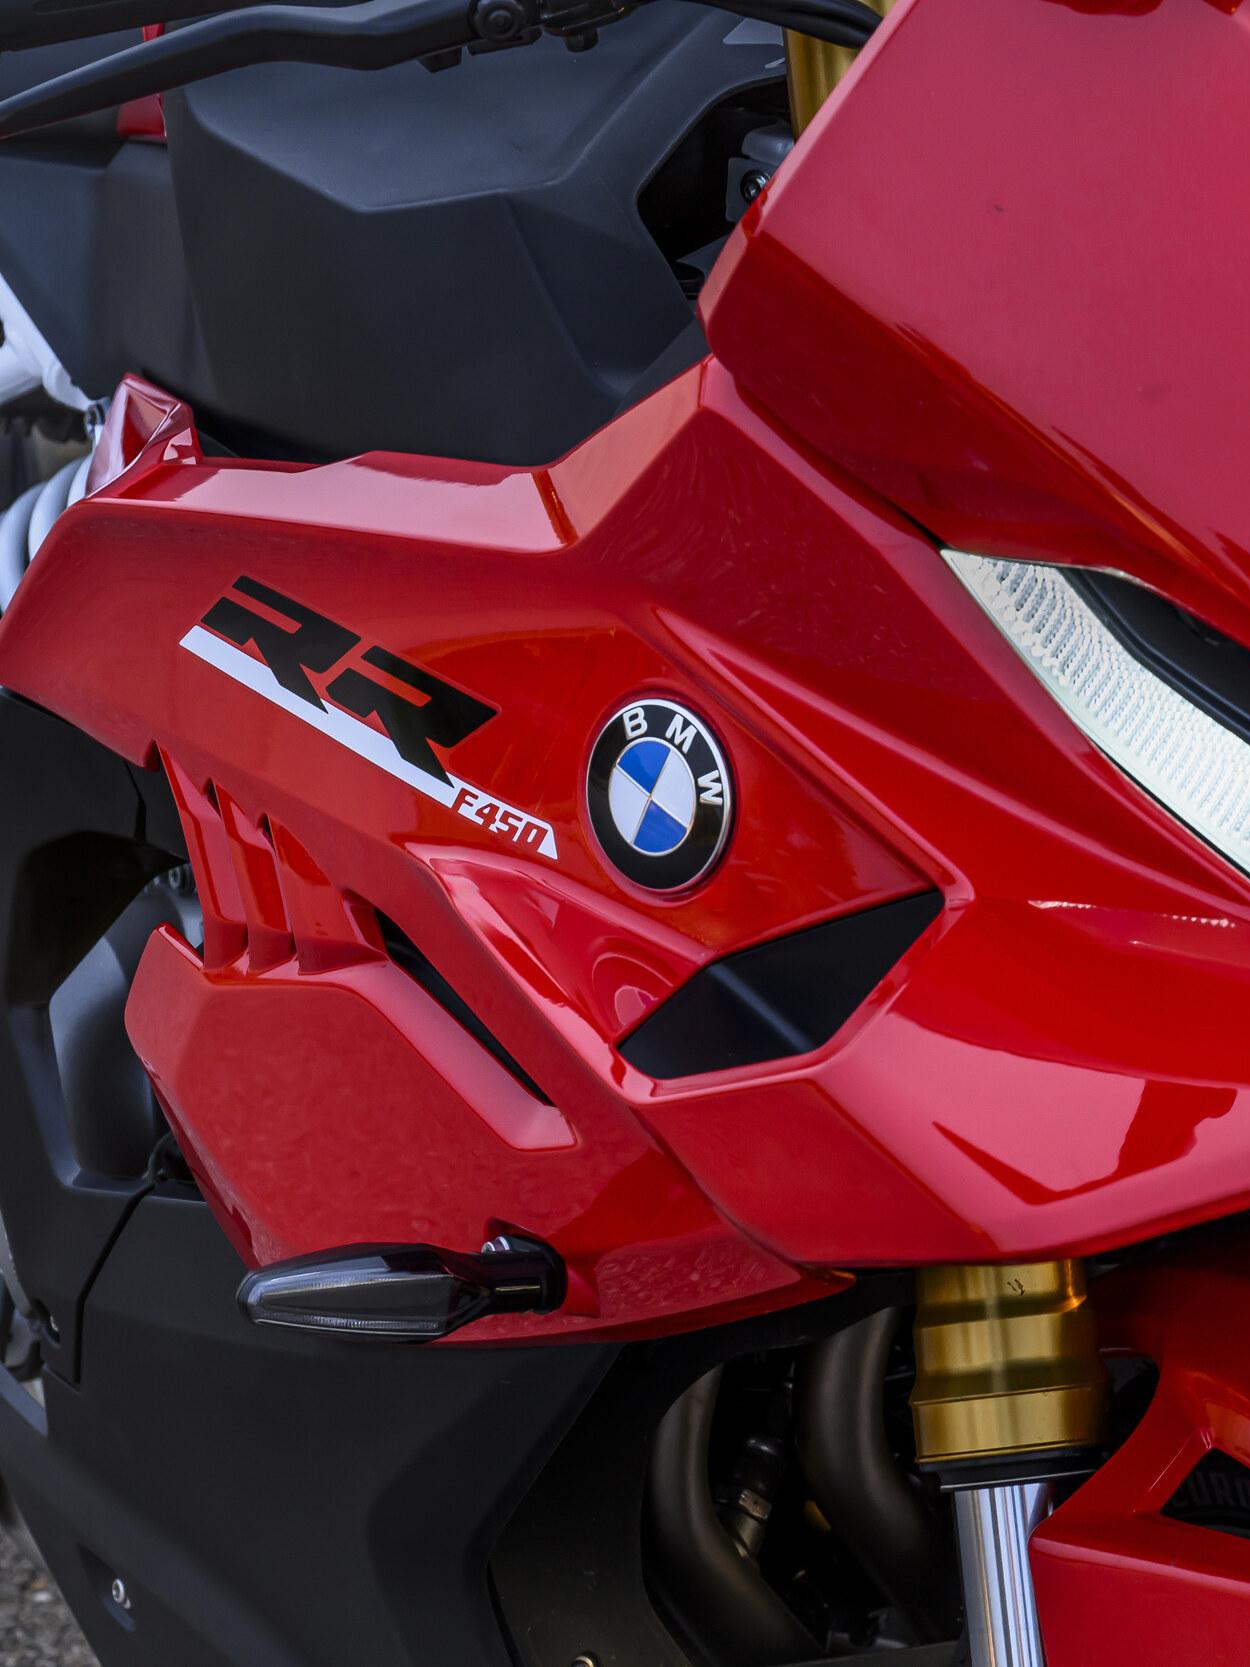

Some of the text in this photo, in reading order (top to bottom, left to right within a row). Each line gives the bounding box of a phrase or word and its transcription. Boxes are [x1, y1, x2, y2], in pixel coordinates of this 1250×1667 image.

[200, 575, 499, 789] RR
[622, 706, 723, 806] BMW
[453, 787, 549, 853] F450
